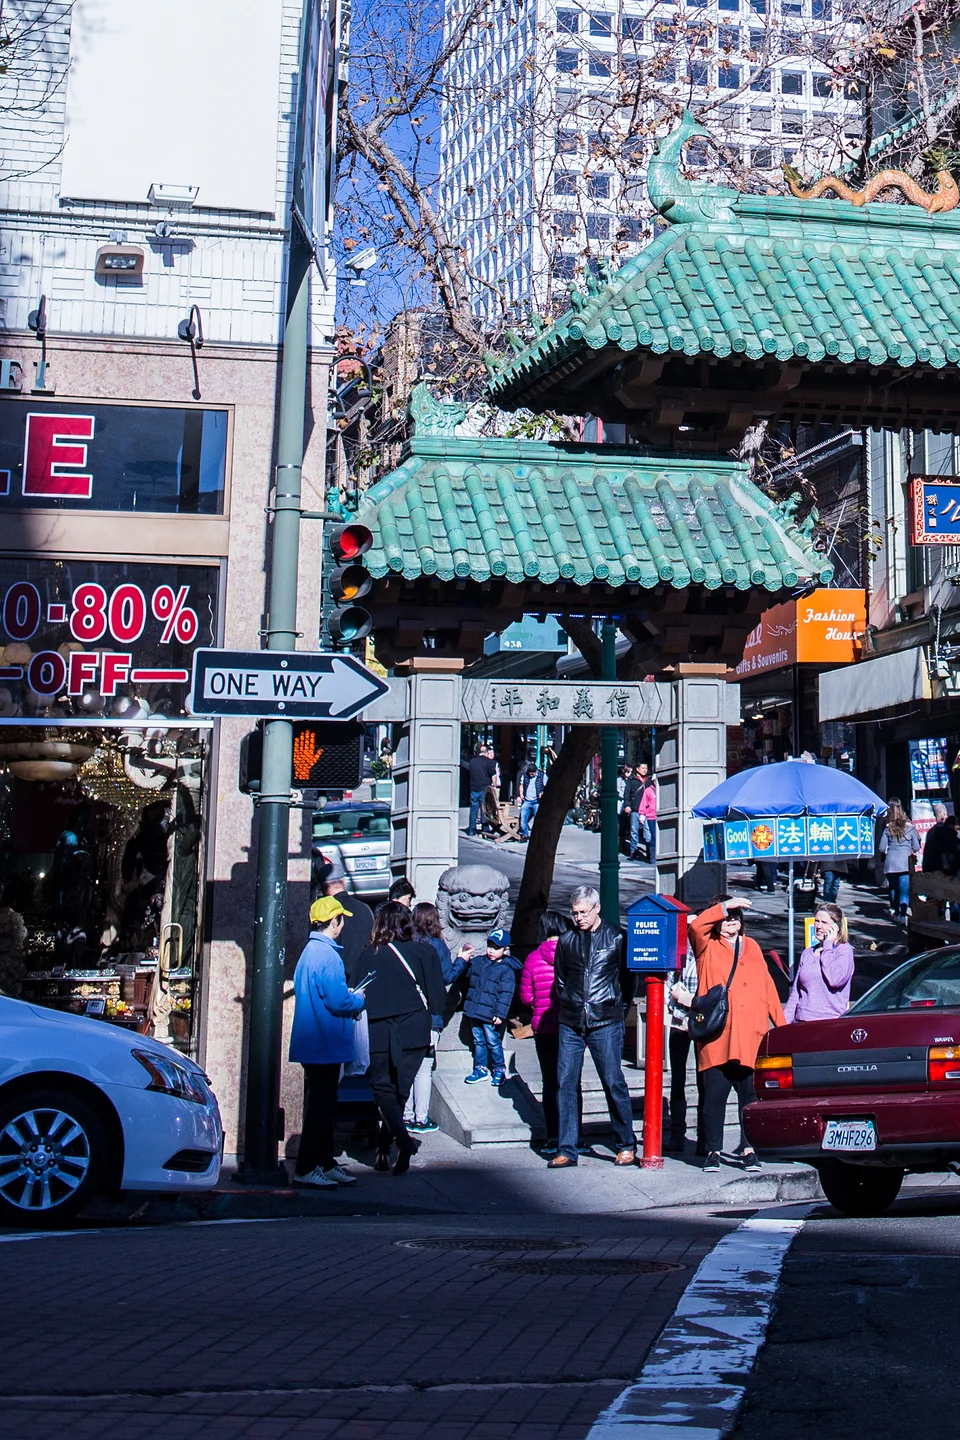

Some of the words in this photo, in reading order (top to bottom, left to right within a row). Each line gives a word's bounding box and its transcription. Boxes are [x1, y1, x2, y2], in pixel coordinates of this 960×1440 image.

[803, 608, 855, 623] Fashion
[757, 648, 788, 668] Souvenirs
[210, 672, 258, 696] ONE
[272, 674, 323, 698] WAY
[727, 828, 747, 844] Good
[837, 1064, 878, 1073] COROLLA
[827, 1129, 873, 1146] 3MHF296
